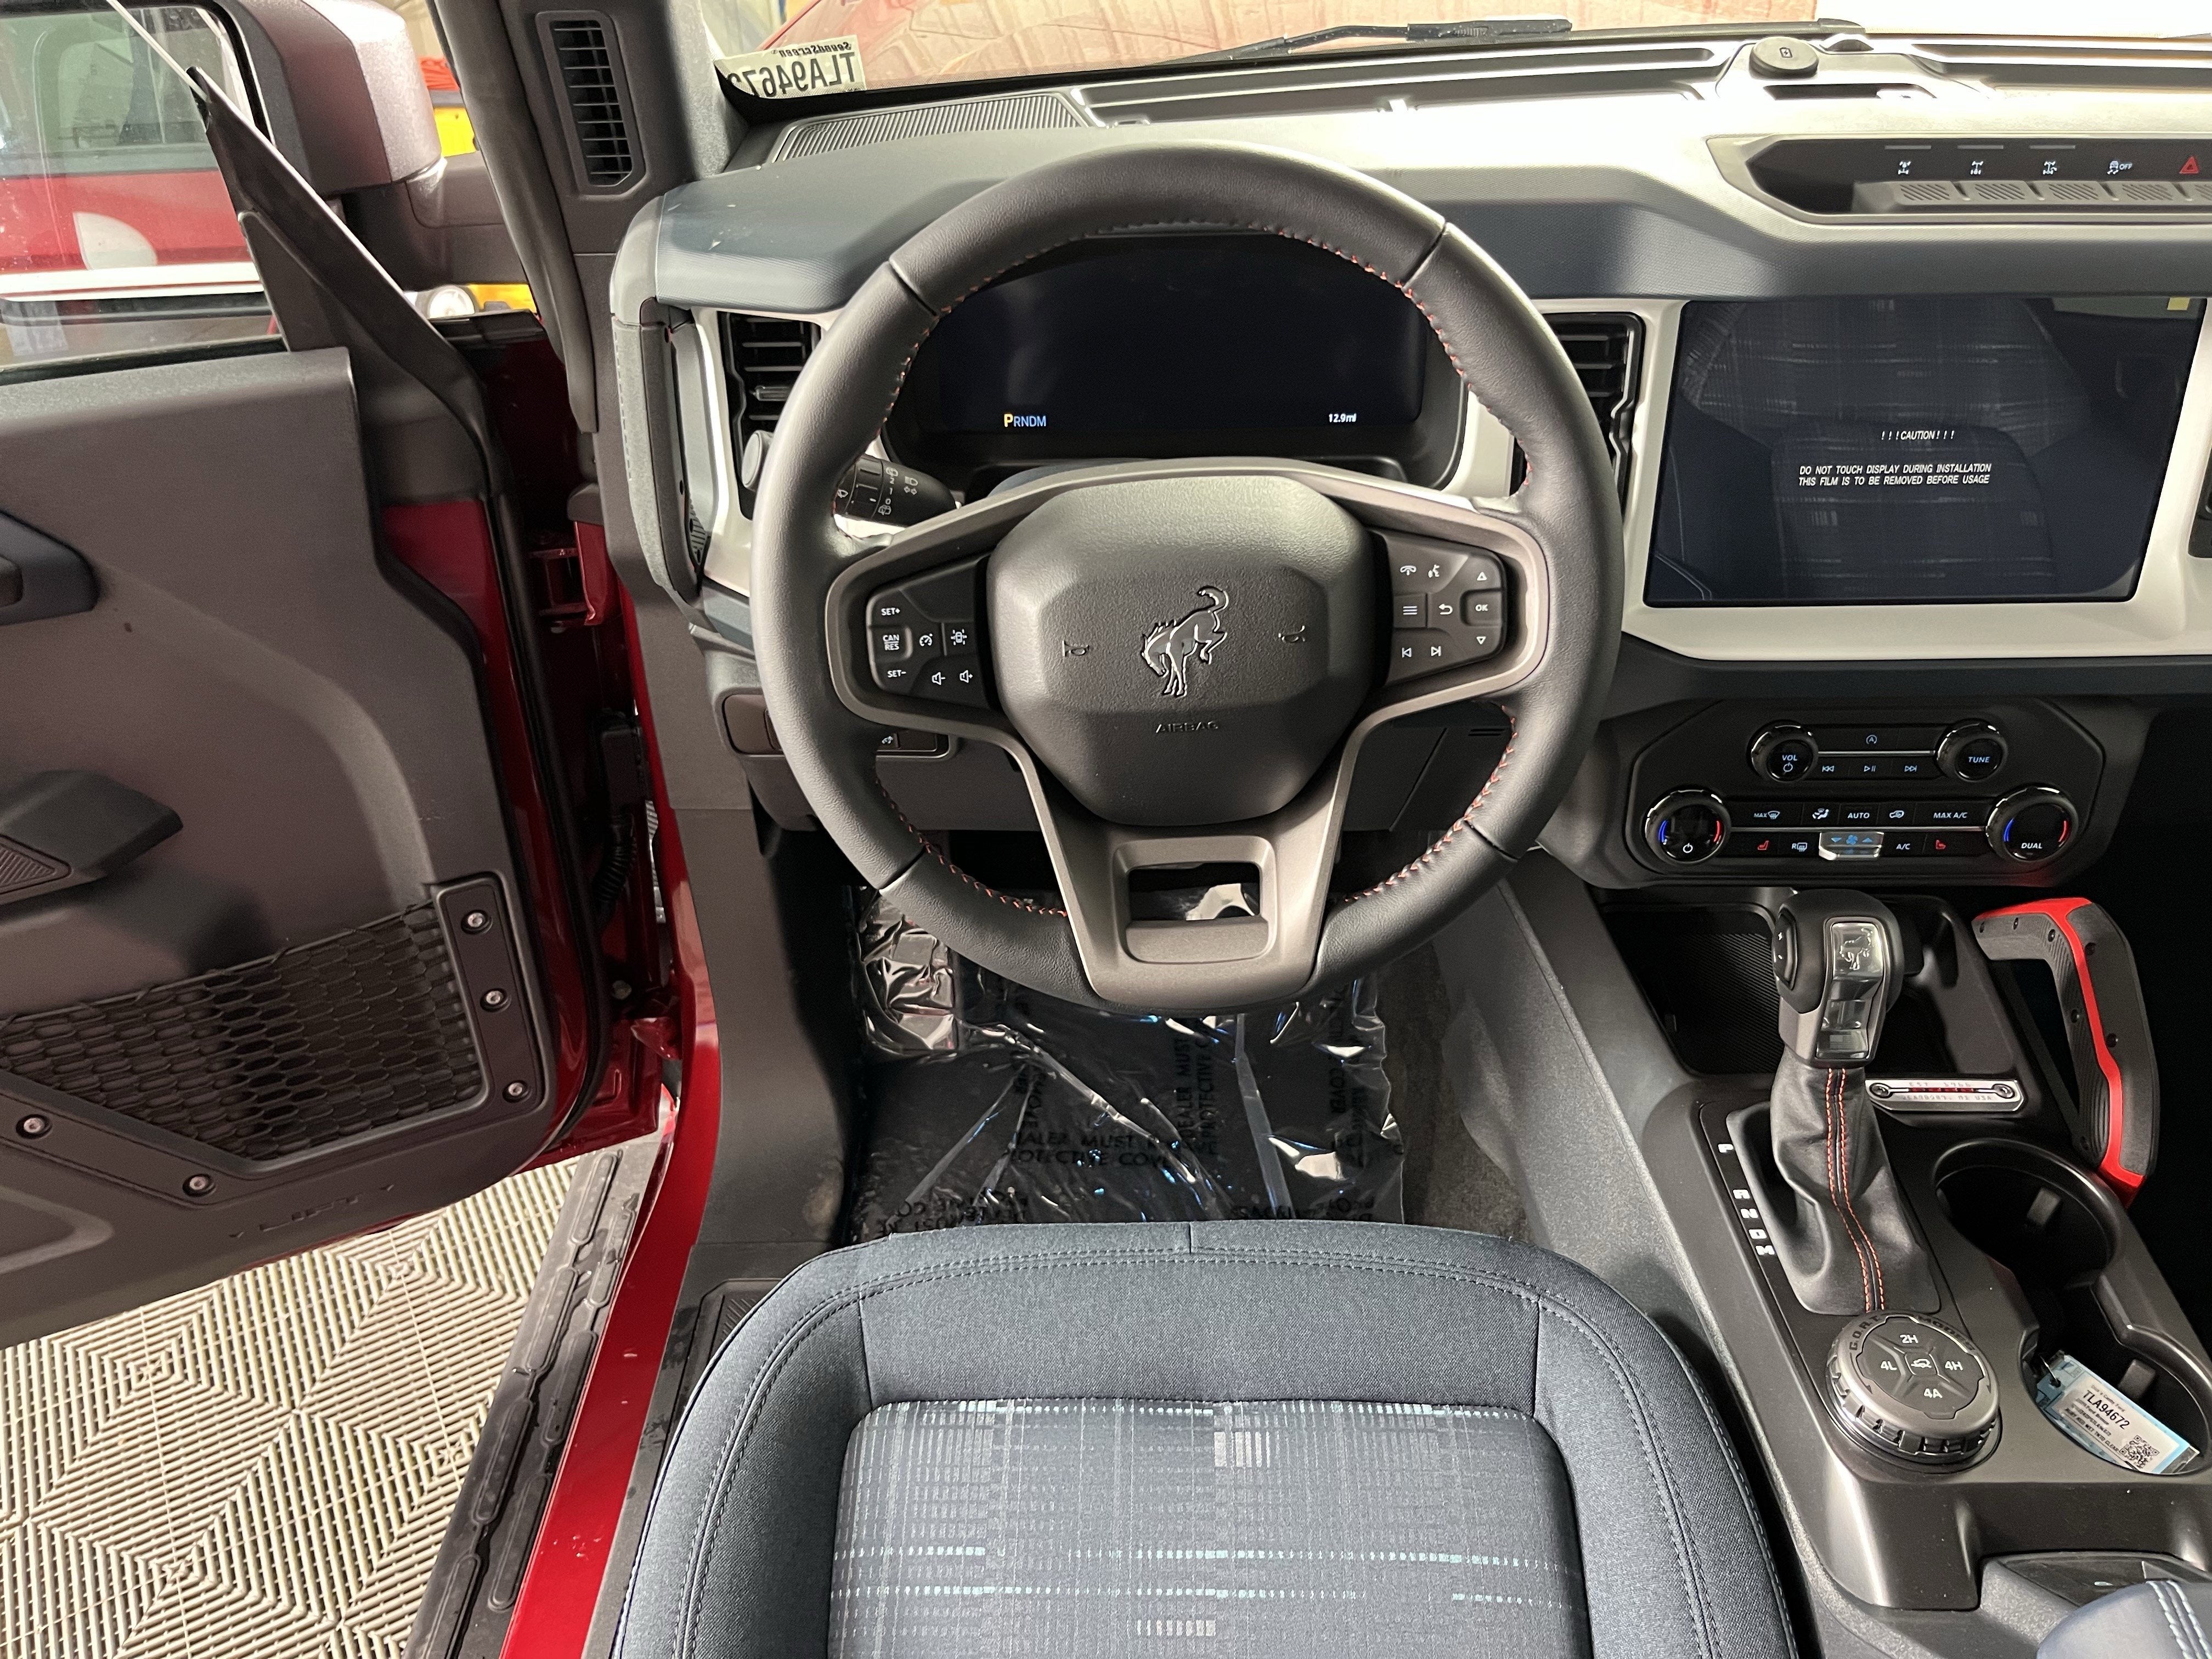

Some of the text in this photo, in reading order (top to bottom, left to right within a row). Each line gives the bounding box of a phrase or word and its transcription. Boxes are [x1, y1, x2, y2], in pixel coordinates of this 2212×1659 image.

[1800, 464, 1991, 475] DO NOT TOUCH DISPLAY DURING INSTALLATION
[1799, 475, 1989, 486] THIS FILM IS TO BE REMOVED BEFORE USAGE
[1475, 603, 1488, 612] OK
[884, 643, 900, 651] RES
[1155, 720, 1219, 733] AIRBAG
[1895, 842, 1911, 850] A/C
[1718, 1143, 1734, 1153] P
[1740, 1208, 1758, 1218] N
[1755, 1245, 1775, 1255] M
[1899, 1334, 1919, 1344] 2H
[1880, 1361, 1897, 1371] 4L
[1945, 1361, 1963, 1371] 4H
[1923, 1388, 1943, 1398] 4A
[2083, 1390, 2130, 1430] TLA94672
